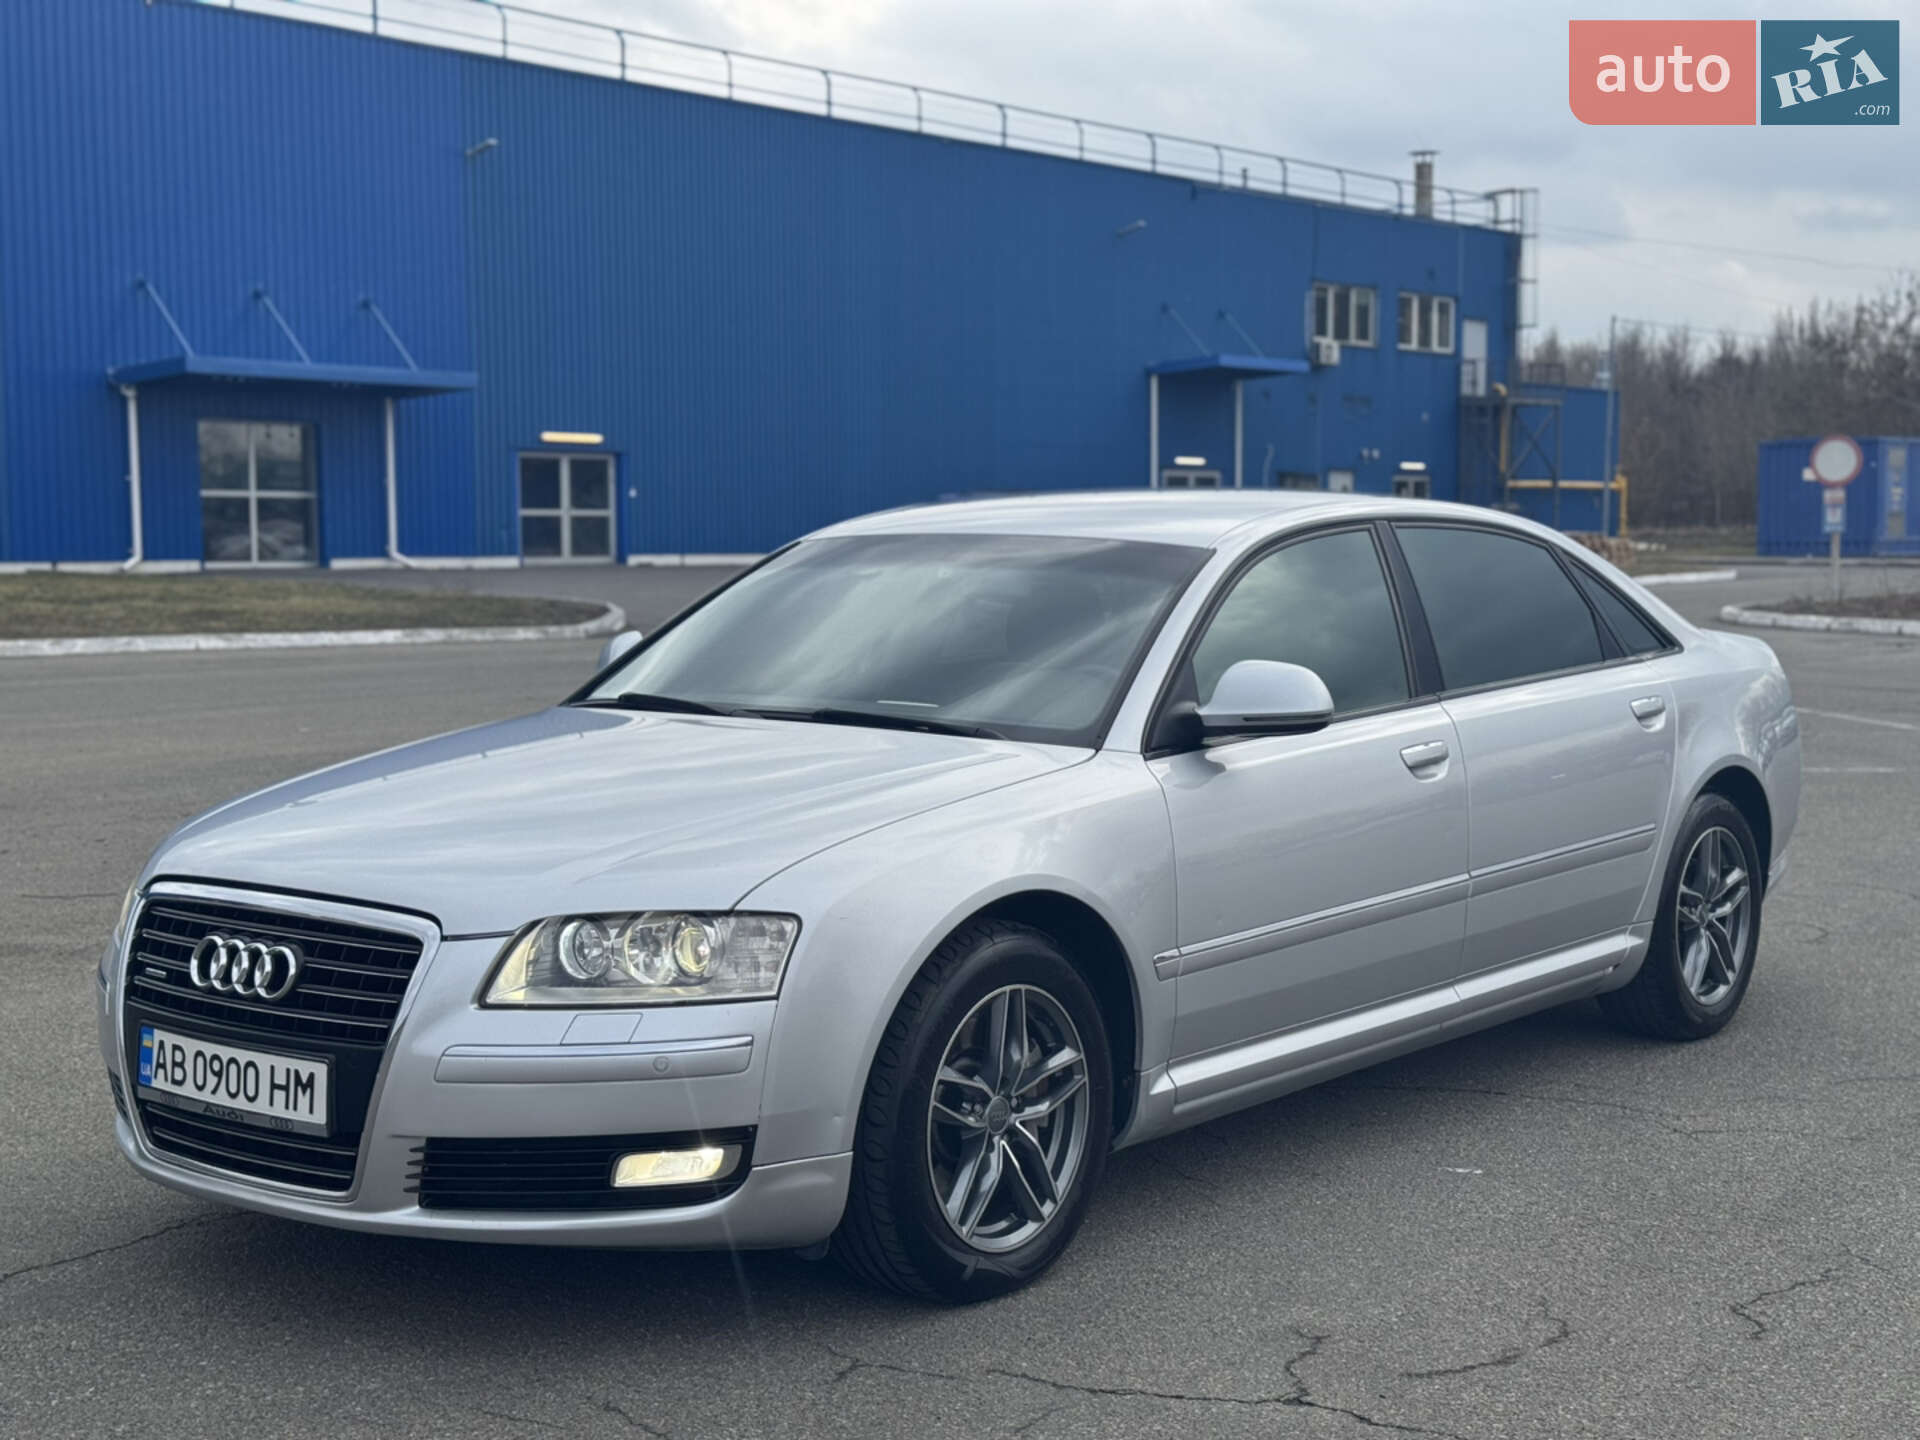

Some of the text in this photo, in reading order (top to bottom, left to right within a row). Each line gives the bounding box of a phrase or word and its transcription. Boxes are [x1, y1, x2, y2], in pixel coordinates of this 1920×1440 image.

[154, 1039, 315, 1115] AB 0900 HM
